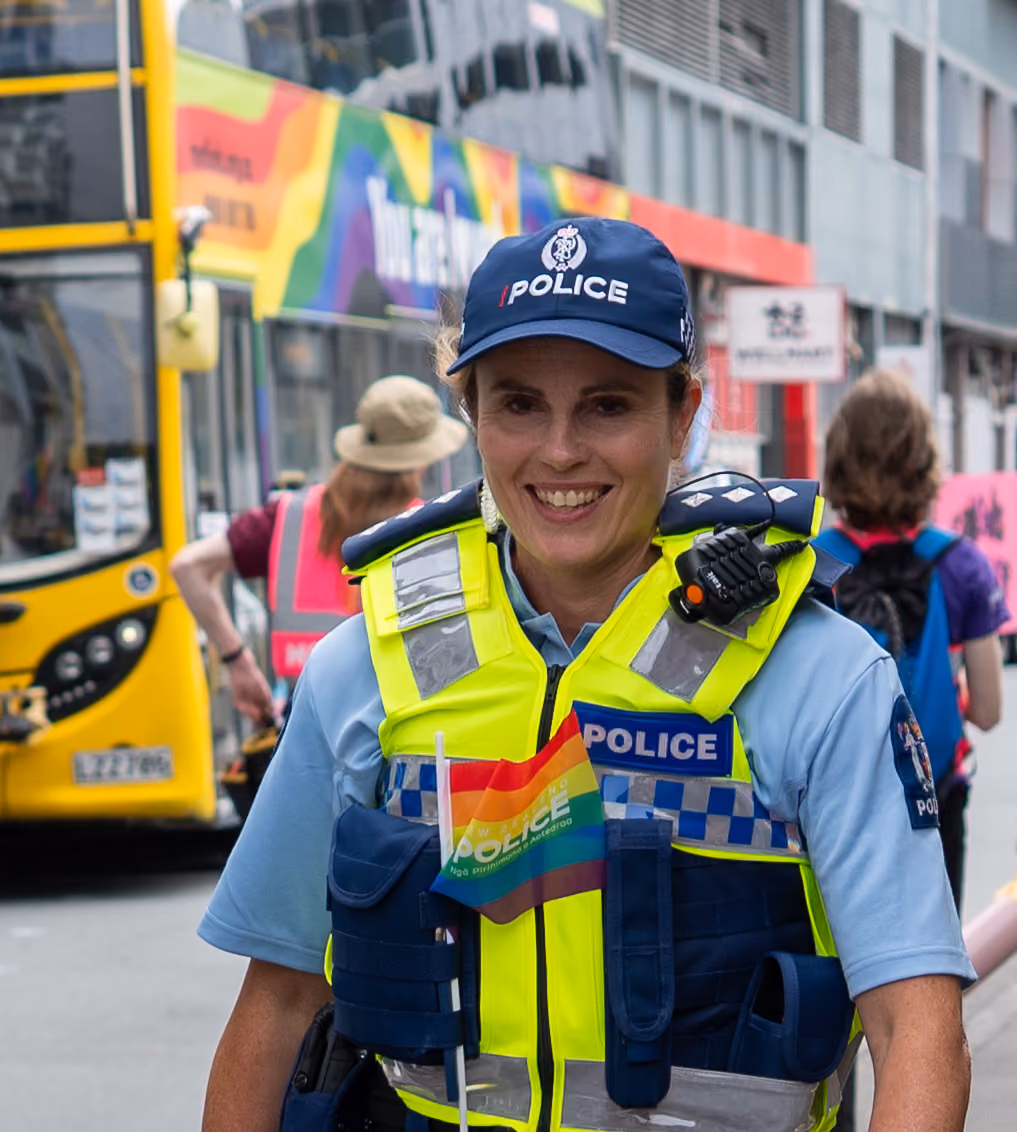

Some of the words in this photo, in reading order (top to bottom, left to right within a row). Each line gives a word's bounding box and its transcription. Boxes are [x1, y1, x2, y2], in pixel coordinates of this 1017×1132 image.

[507, 272, 629, 305] POLICE
[584, 723, 718, 760] POLICE
[452, 789, 571, 864] POLICE
